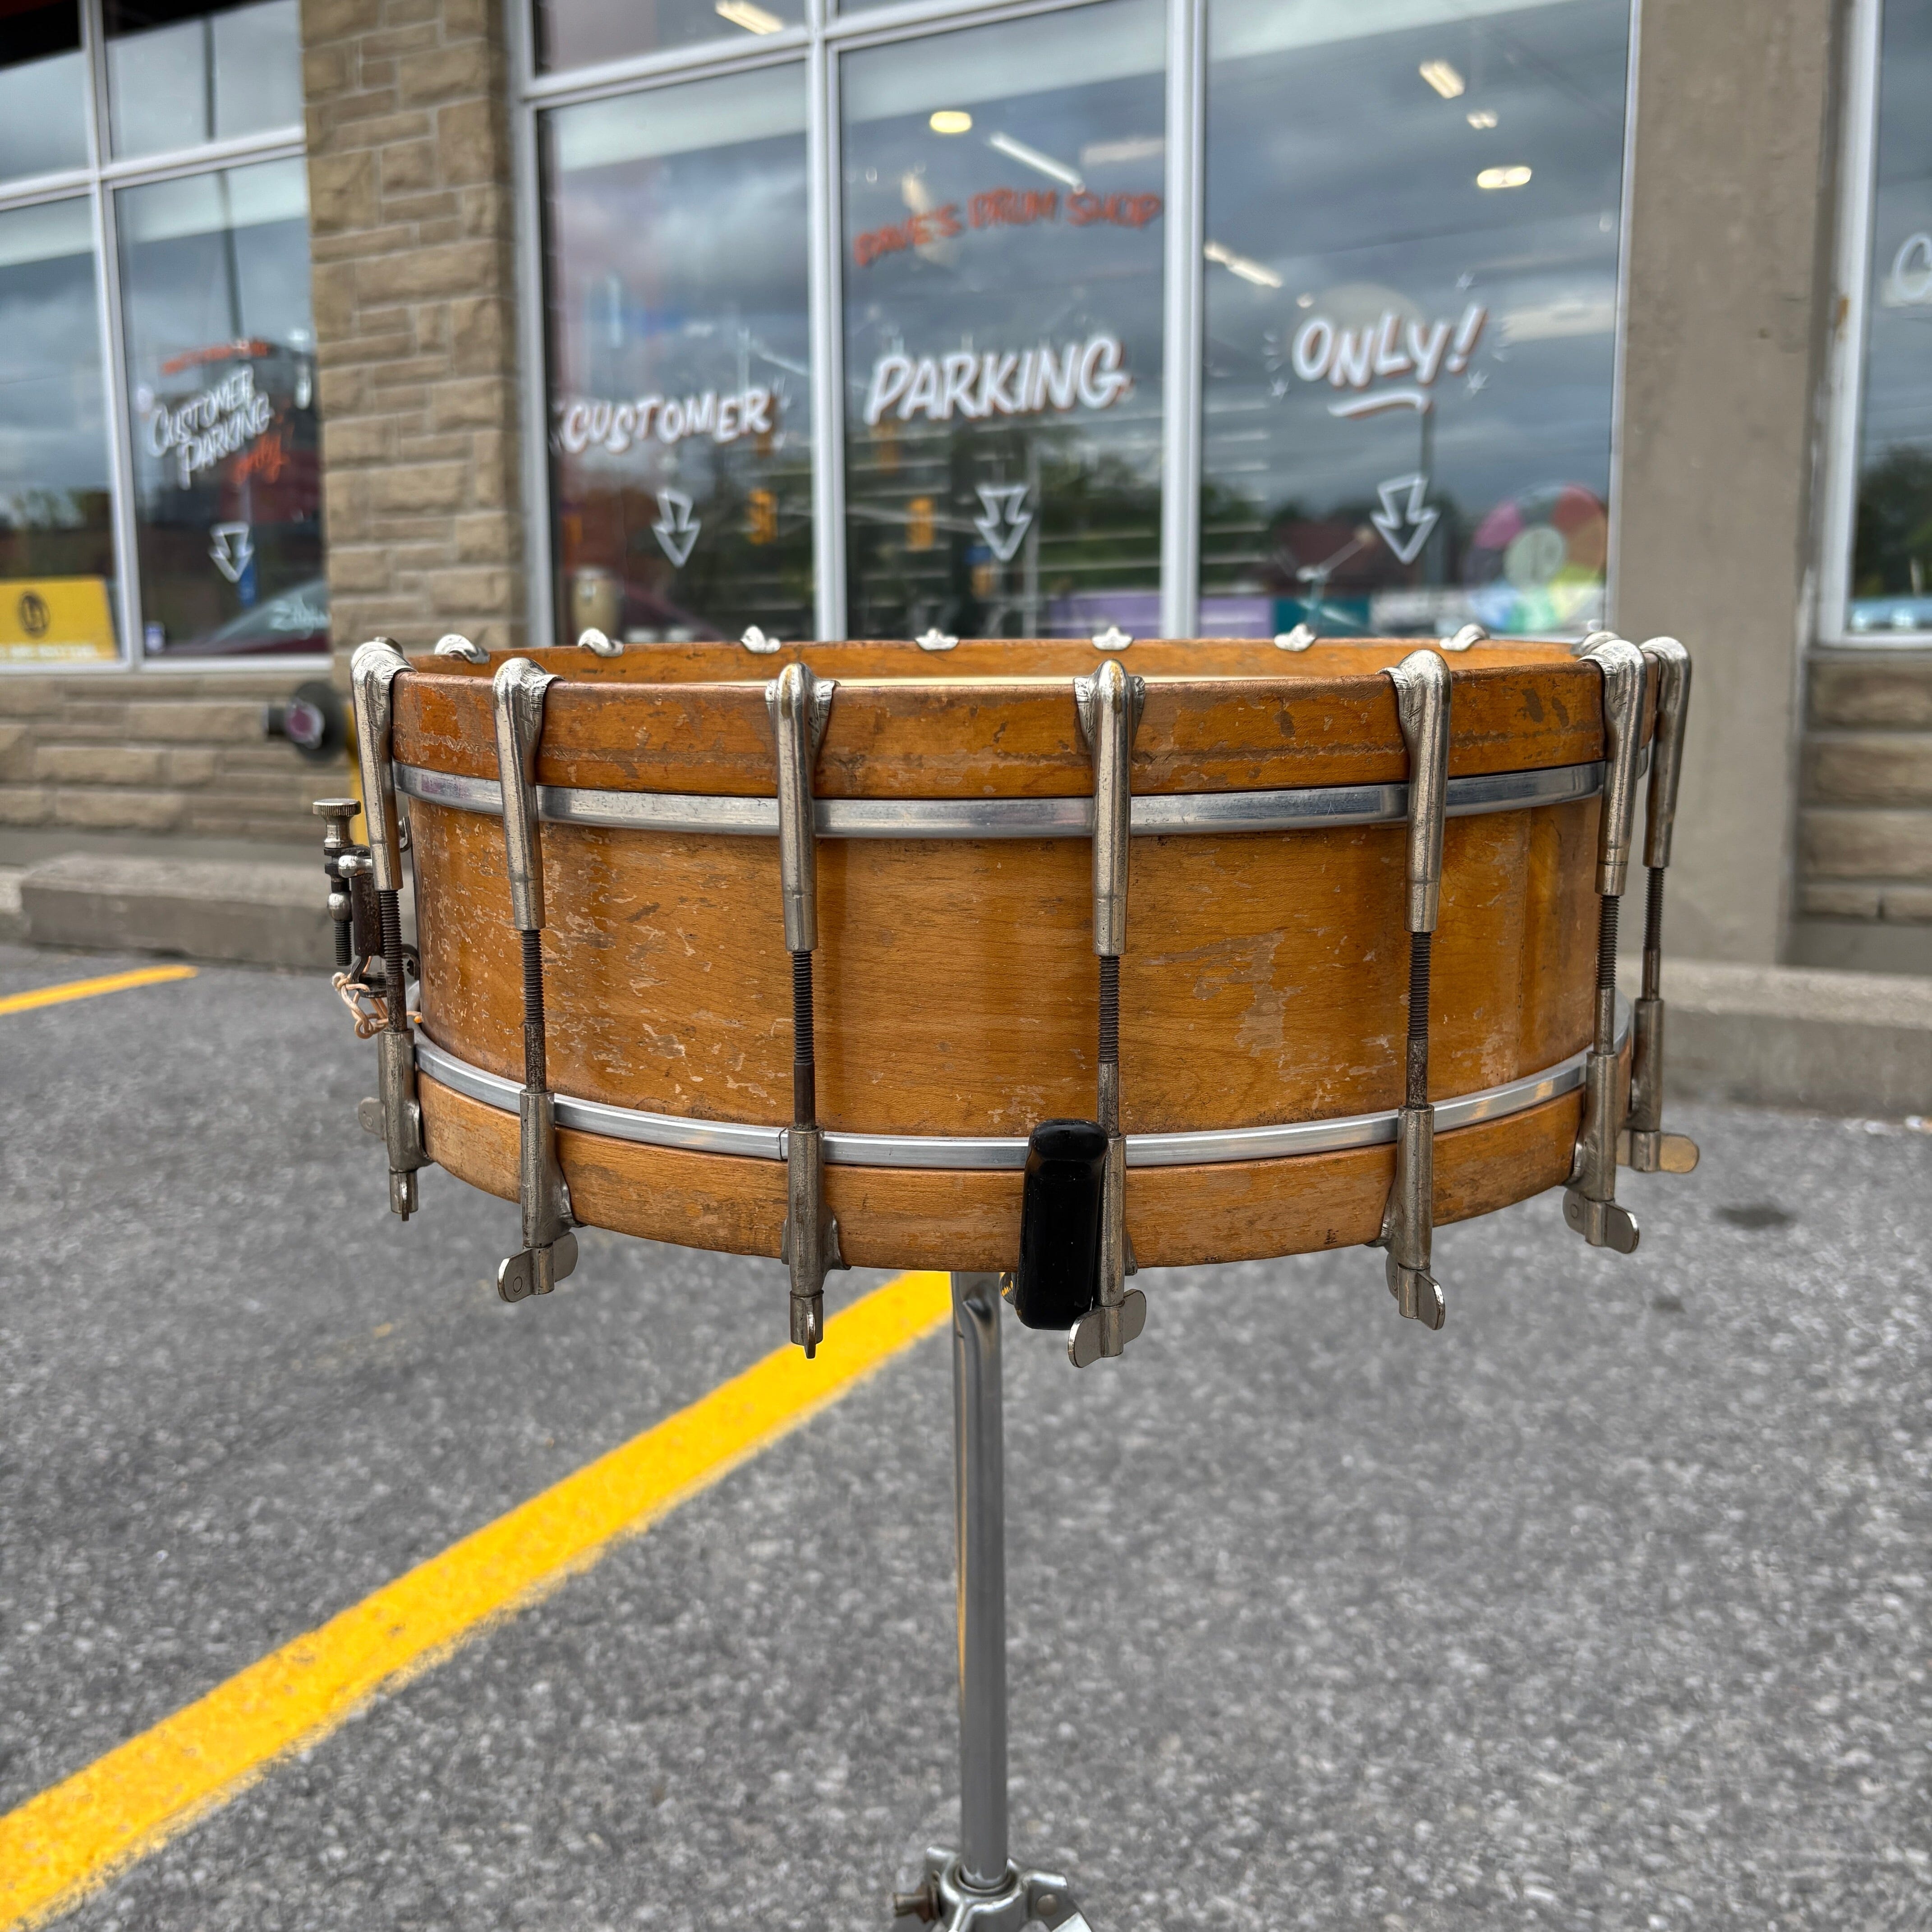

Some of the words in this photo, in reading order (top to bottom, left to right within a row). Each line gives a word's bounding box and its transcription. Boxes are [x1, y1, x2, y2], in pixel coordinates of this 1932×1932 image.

[968, 187, 1058, 227] DRUM
[1065, 191, 1162, 229] SHOP
[863, 336, 1129, 425] PARKING
[1292, 303, 1487, 389] ONLY!
[562, 386, 773, 453] CUSTOMER
